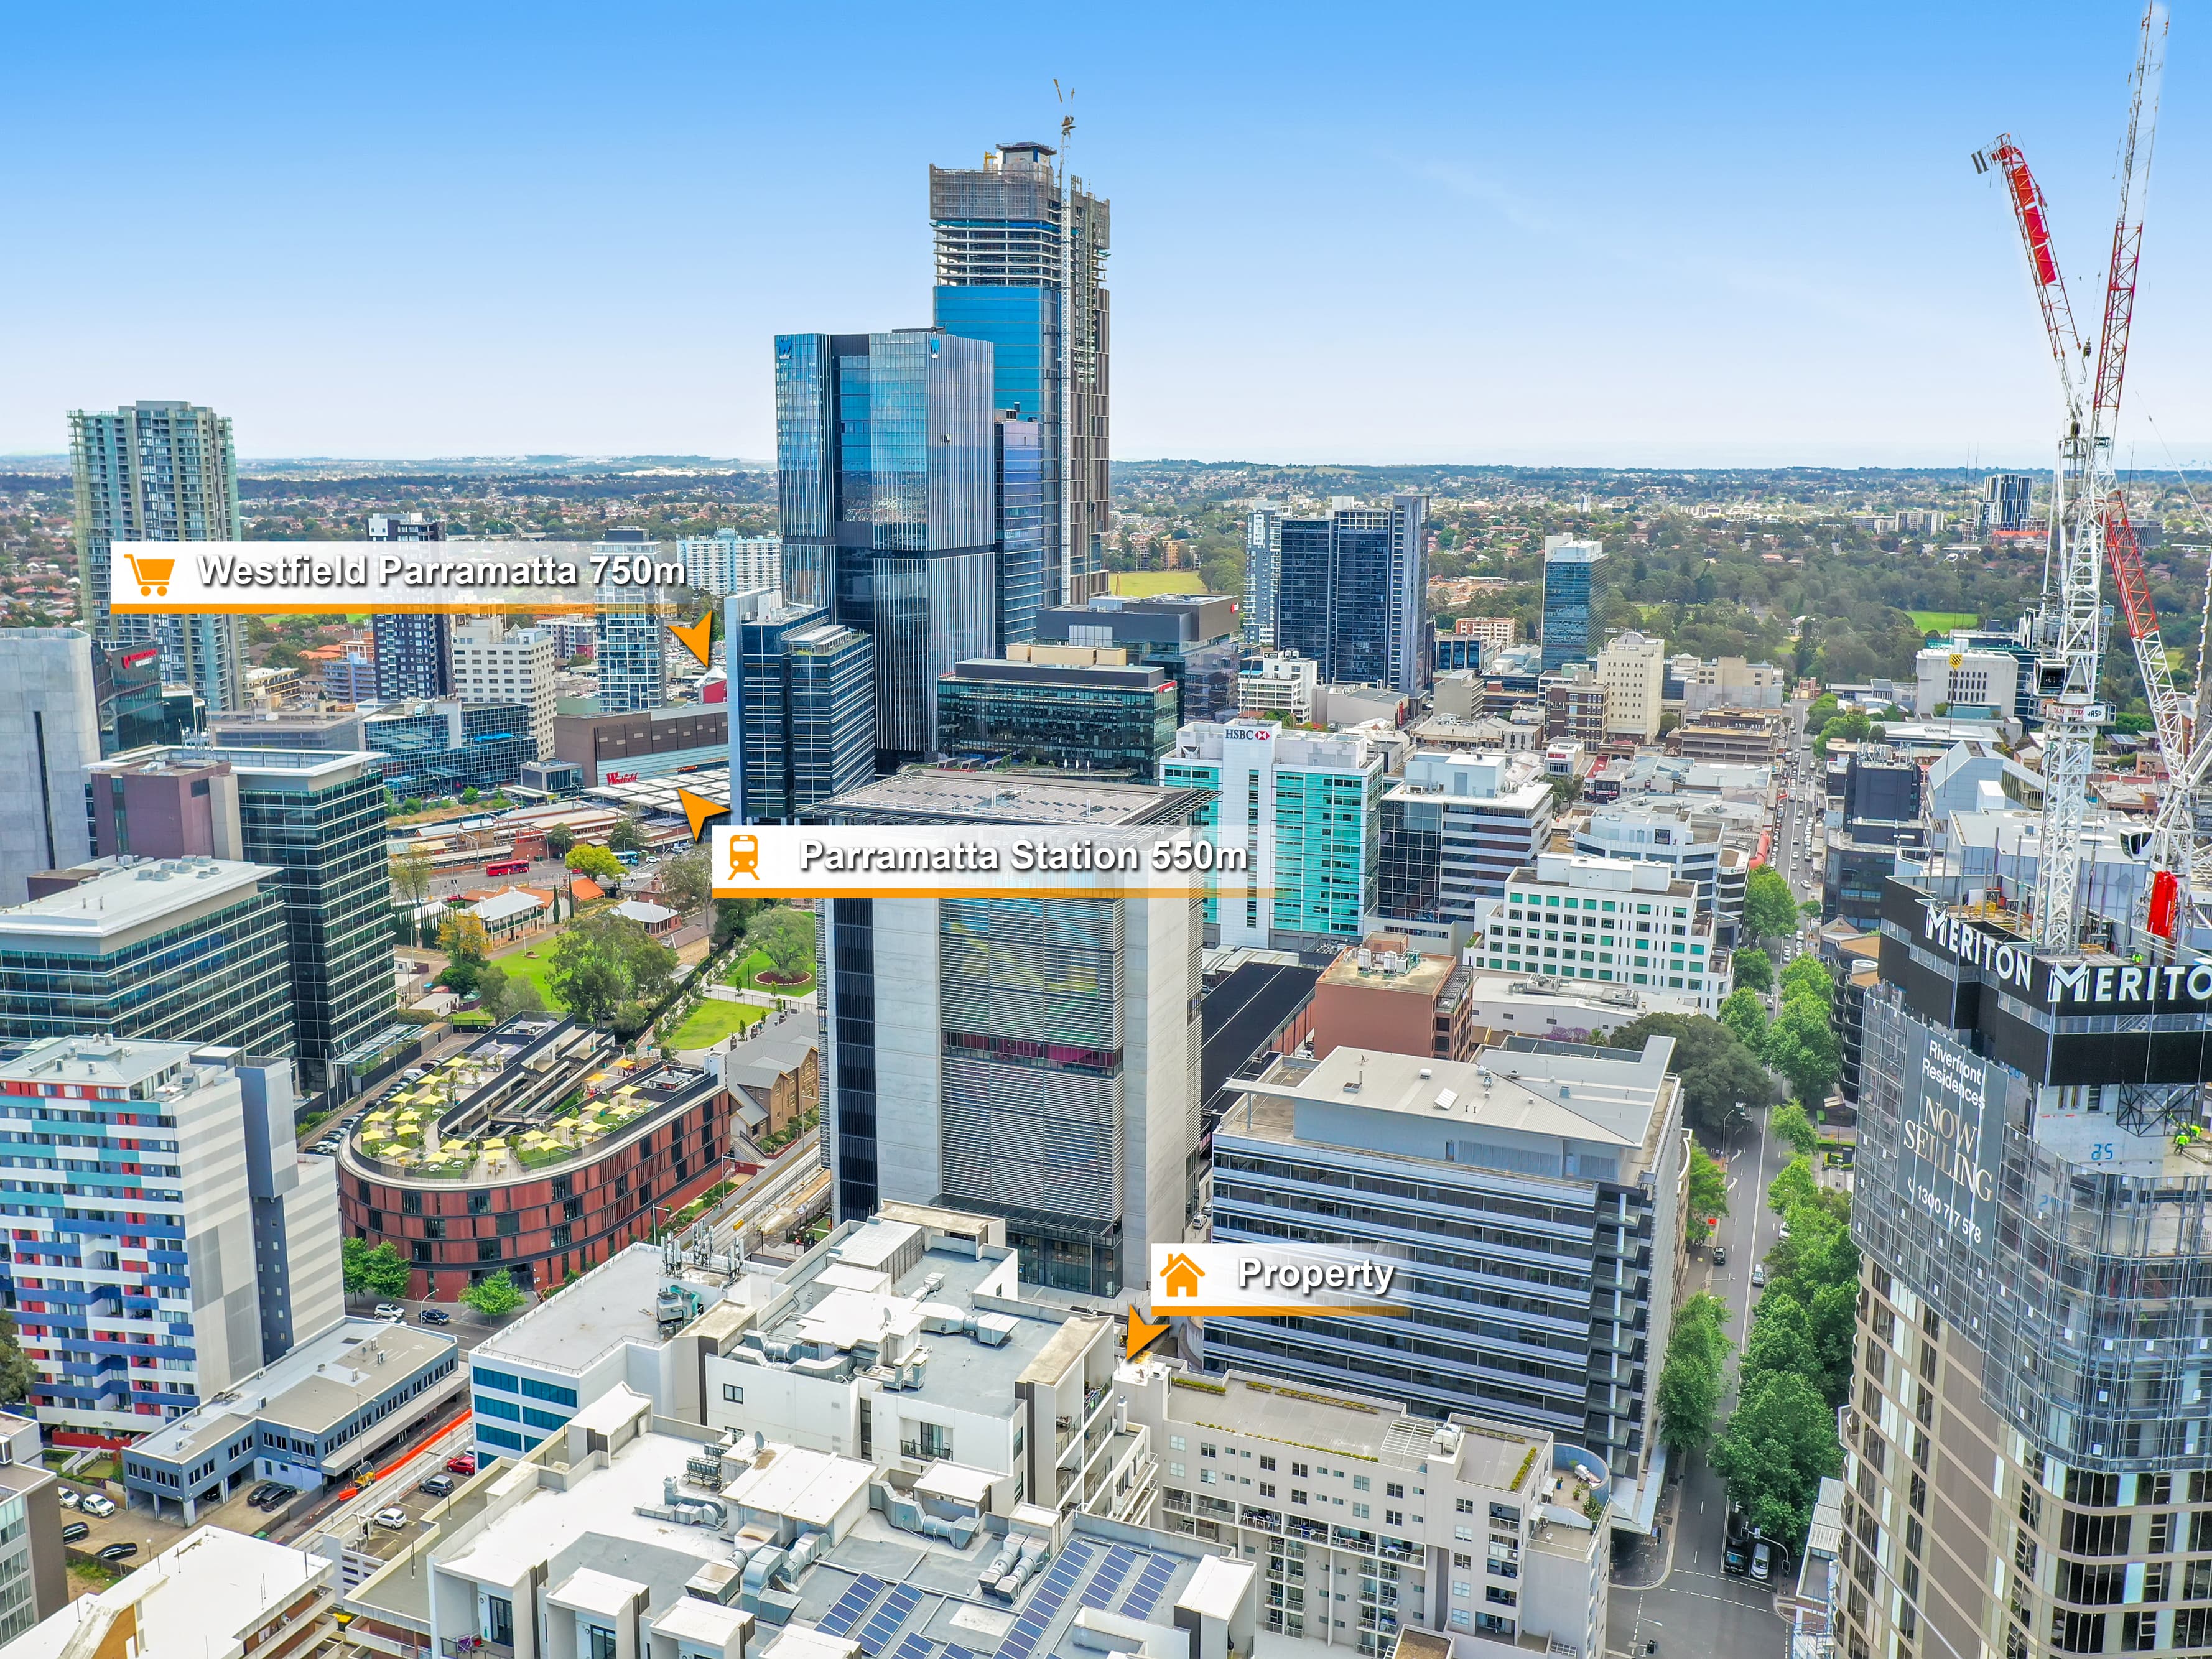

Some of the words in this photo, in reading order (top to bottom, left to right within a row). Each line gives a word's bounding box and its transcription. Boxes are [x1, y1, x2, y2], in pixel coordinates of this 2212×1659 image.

[1225, 729, 1253, 740] HSBC
[606, 771, 638, 785] Westfield
[1925, 902, 2032, 992] MERITON
[1922, 1058, 1986, 1110] Residences
[1930, 1039, 1982, 1085] Riverfront
[1923, 1095, 1978, 1154] NOW
[1904, 1120, 1992, 1202] SELLING
[2091, 1143, 2112, 1160] 25
[1918, 1185, 1941, 1214] 1300
[1944, 1202, 1960, 1228] 717
[1961, 1217, 1981, 1243] 578
